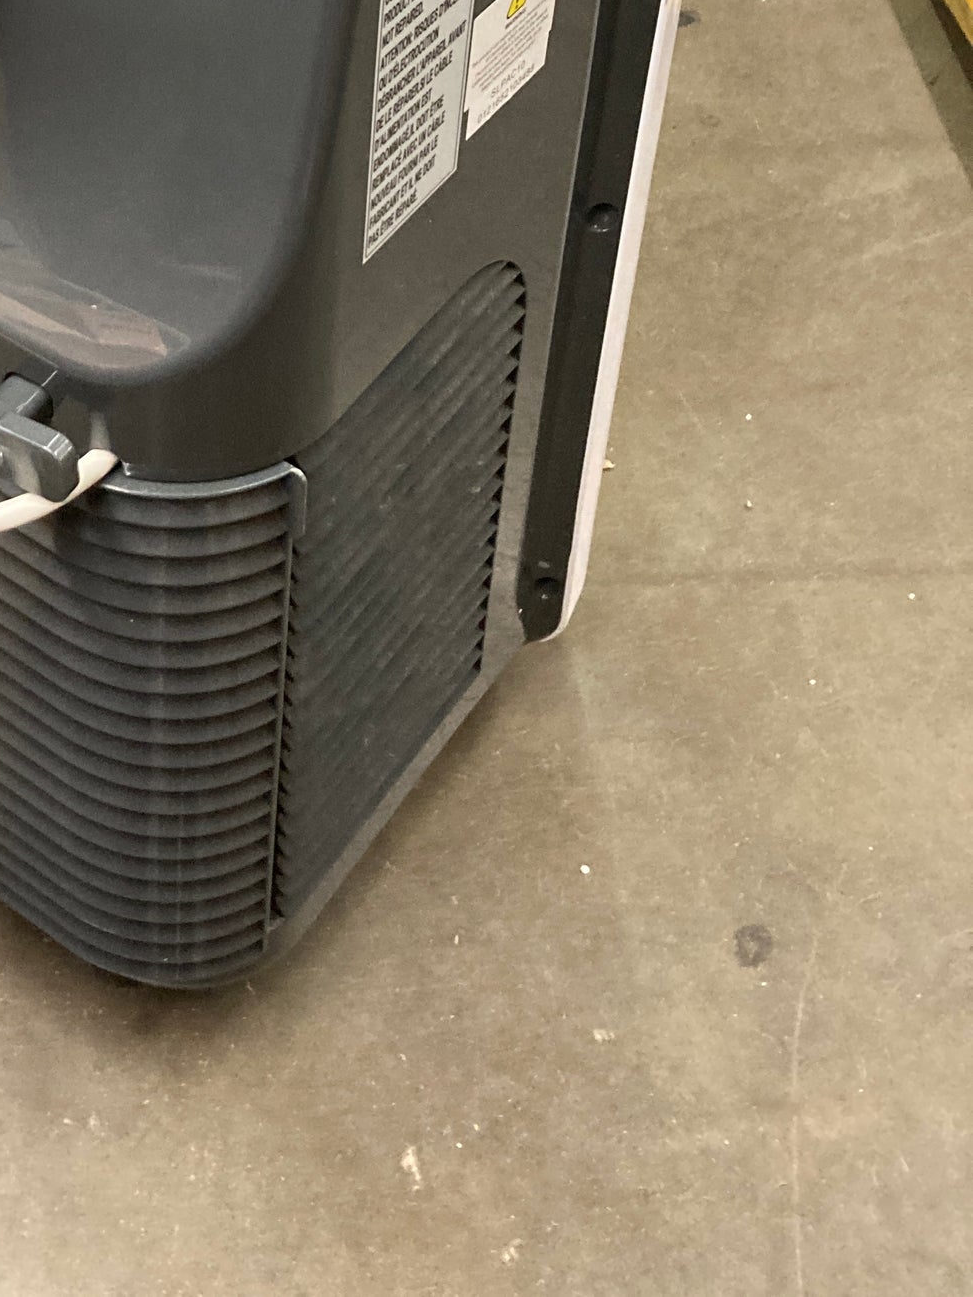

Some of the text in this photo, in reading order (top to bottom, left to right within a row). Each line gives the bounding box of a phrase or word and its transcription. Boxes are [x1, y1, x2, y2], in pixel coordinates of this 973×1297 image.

[381, 26, 394, 48] NOT
[413, 8, 438, 39] RISQUES
[447, 19, 466, 45] AVANT
[375, 115, 384, 132] DE
[384, 107, 392, 124] LE
[425, 68, 433, 84] LE
[420, 87, 432, 107] EST
[415, 108, 429, 130] DOIT
[402, 137, 417, 160] AVEC
[418, 129, 426, 145] UN
[370, 134, 438, 210] NOUVEAU FOURNI PAR LE
[369, 189, 399, 228] FABRICANT
[400, 181, 408, 198] ET
[414, 168, 422, 183] NE
[422, 154, 435, 175] DOIT
[367, 228, 379, 248] PAS
